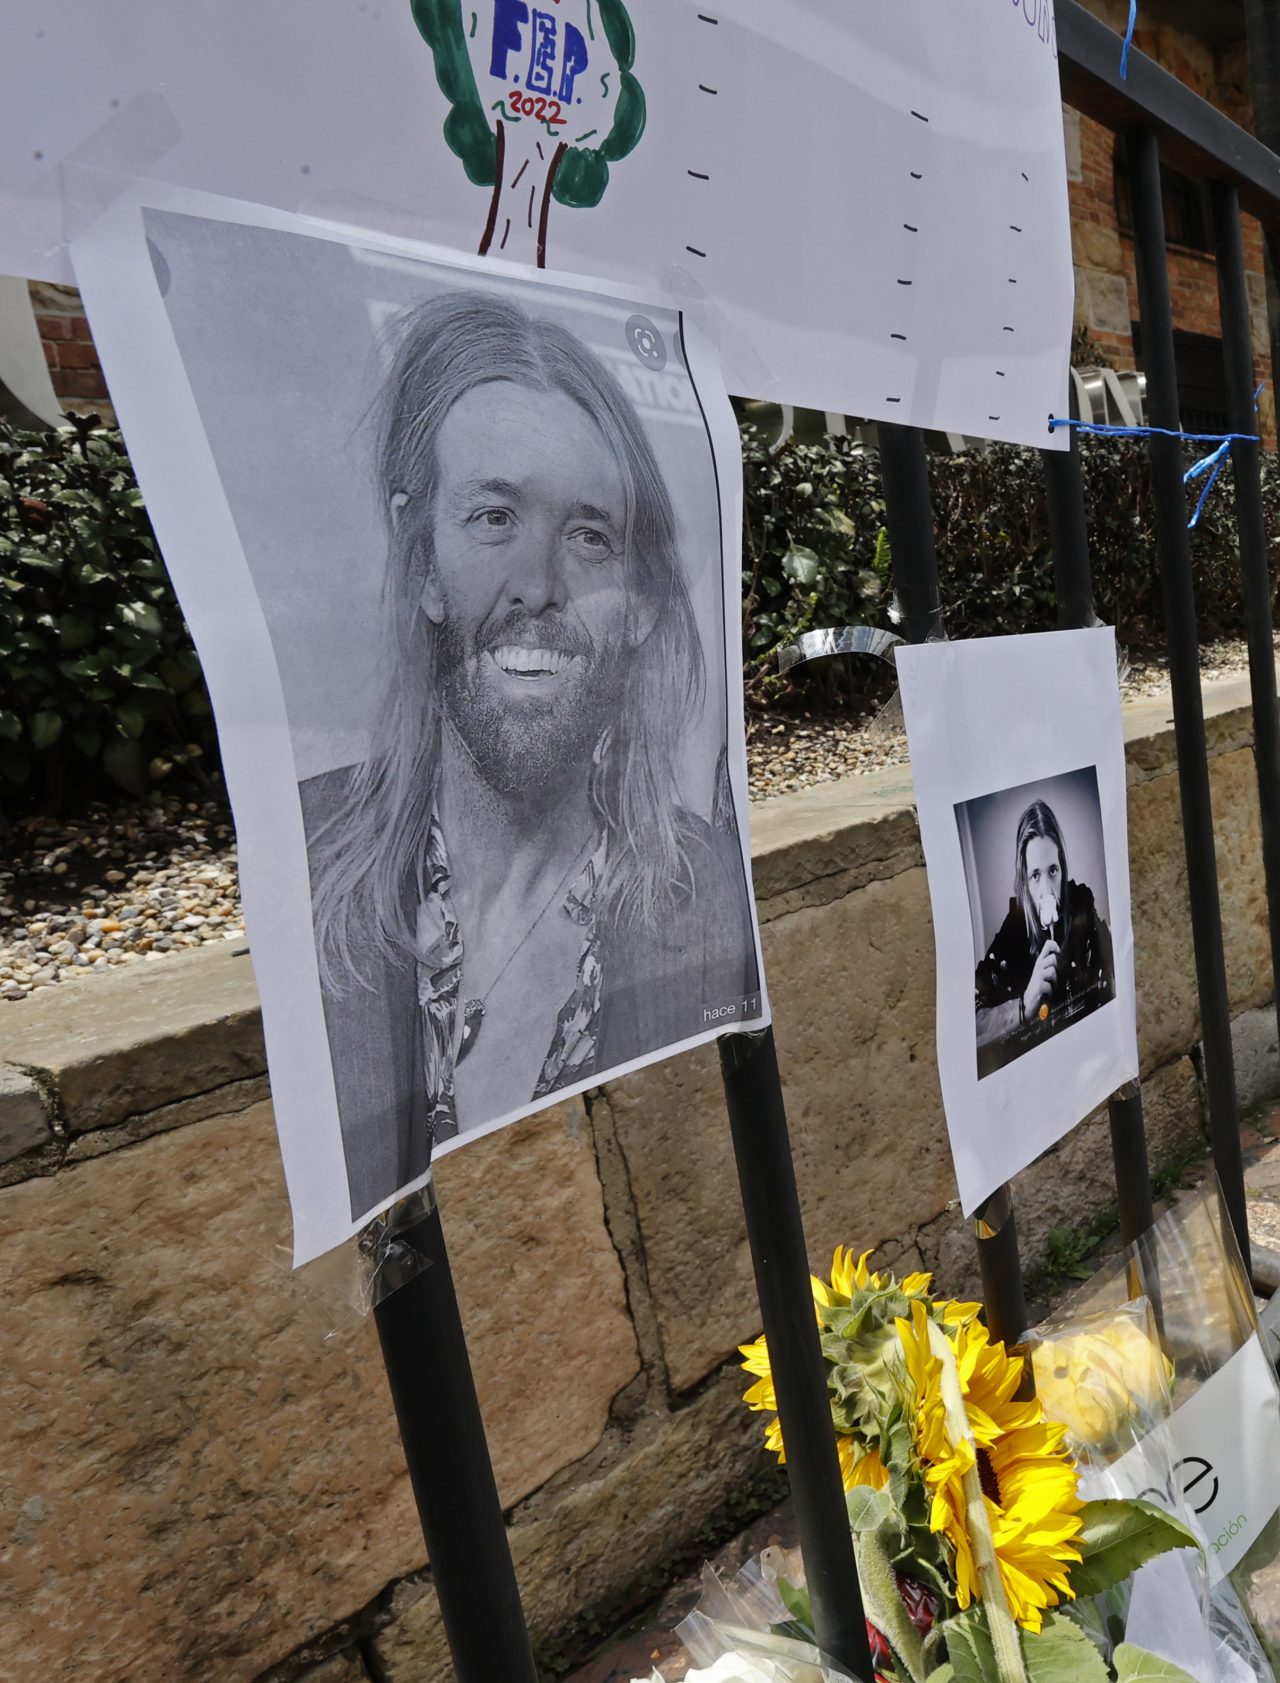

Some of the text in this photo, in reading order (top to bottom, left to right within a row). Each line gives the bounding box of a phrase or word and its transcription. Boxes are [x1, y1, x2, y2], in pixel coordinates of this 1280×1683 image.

[508, 90, 568, 125] 2022
[703, 997, 757, 1022] hace 11
[1209, 1513, 1248, 1554] ación
